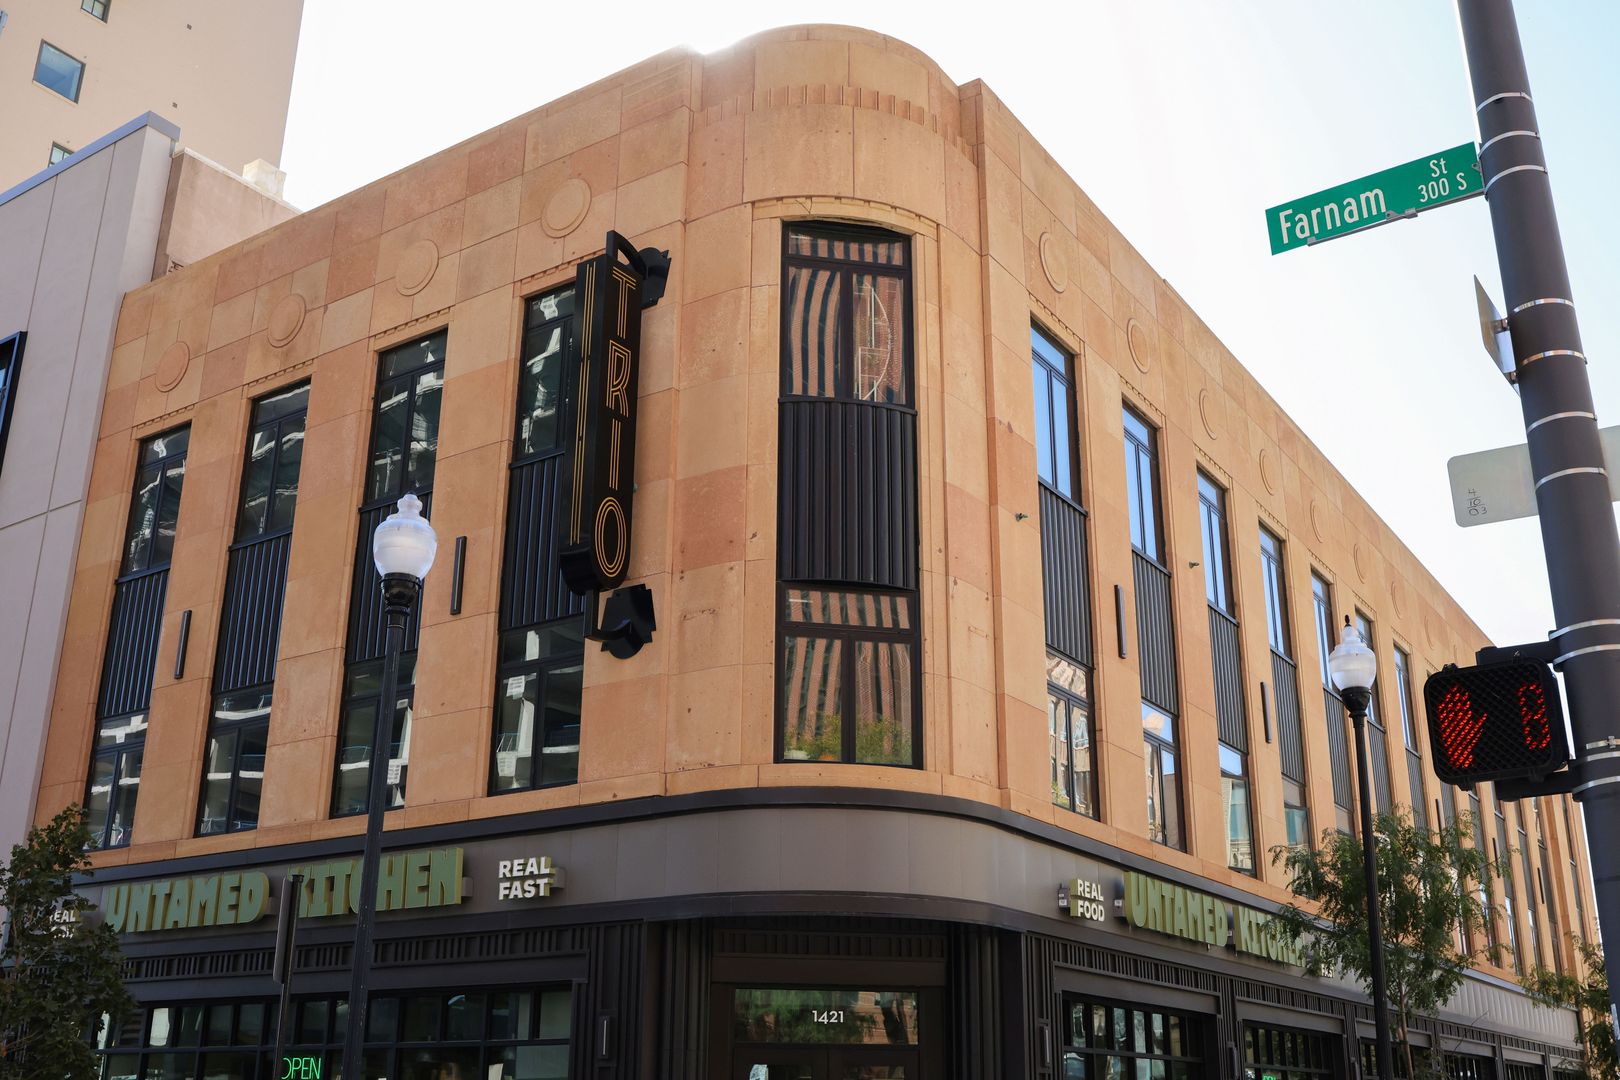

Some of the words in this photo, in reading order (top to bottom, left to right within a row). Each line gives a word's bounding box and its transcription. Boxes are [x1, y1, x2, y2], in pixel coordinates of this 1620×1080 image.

[1429, 157, 1448, 178] St
[1417, 177, 1450, 203] 300
[1456, 172, 1468, 191] S
[1279, 187, 1387, 245] Farnam
[594, 265, 637, 579] TRIO
[498, 856, 551, 879] REAL
[498, 877, 549, 900] FAST
[1076, 878, 1105, 902] REAL
[105, 871, 269, 933] UNTAMED
[1076, 899, 1106, 922] FOOD
[1127, 871, 1229, 947] UNTAMED
[811, 1010, 844, 1025] 1421
[280, 1057, 322, 1080] OPEN
